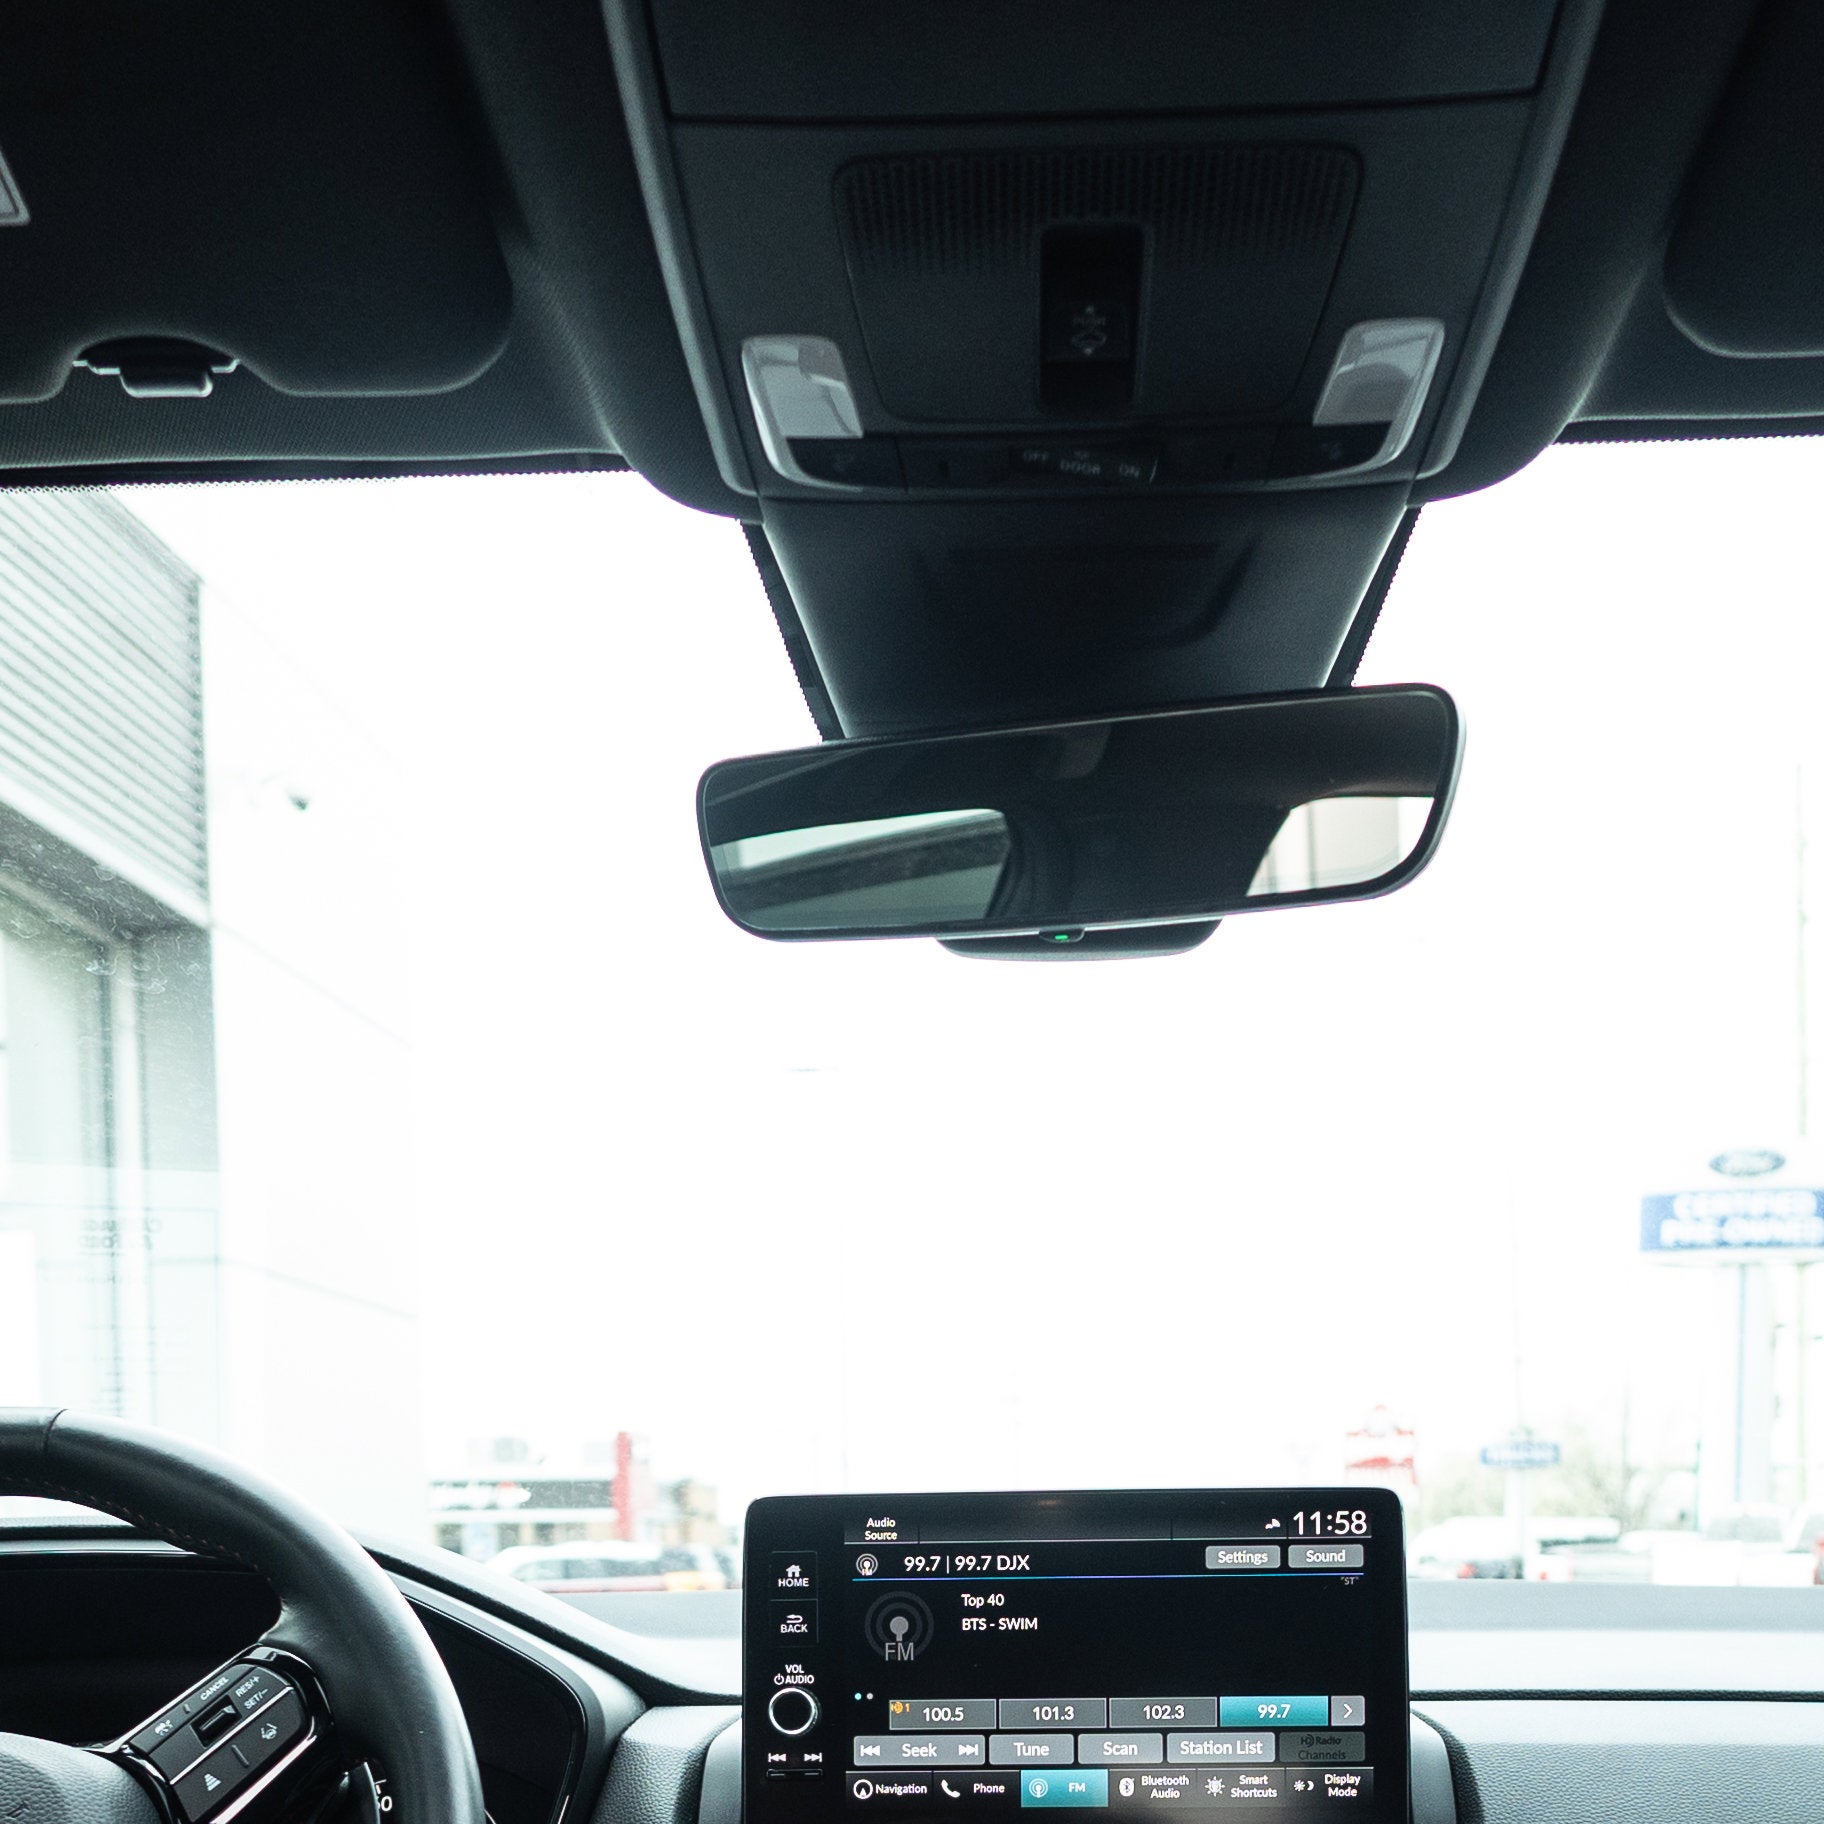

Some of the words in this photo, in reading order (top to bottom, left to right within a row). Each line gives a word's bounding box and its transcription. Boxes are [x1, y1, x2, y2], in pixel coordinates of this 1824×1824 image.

[866, 1517, 897, 1529] Audio
[1291, 1510, 1368, 1536] 11:58
[864, 1530, 898, 1541] Source
[904, 1555, 940, 1572] 99.7
[954, 1555, 992, 1572] 99.7
[997, 1555, 1030, 1572] DJX
[1216, 1549, 1269, 1566] Settings
[1305, 1548, 1346, 1564] Sound
[777, 1577, 810, 1588] HOME
[961, 1594, 983, 1610] Top
[986, 1593, 1005, 1607] 40
[780, 1623, 809, 1634] BACK
[961, 1618, 986, 1631] BTS
[998, 1617, 1038, 1631] SWIM
[884, 1642, 915, 1661] FM
[784, 1664, 805, 1674] VOL
[235, 1675, 260, 1698] RES/+
[784, 1674, 815, 1684] AUDIO
[200, 1676, 230, 1701] CANCEL
[922, 1706, 965, 1722] 100.5
[1032, 1705, 1075, 1721] 101.3
[1142, 1705, 1185, 1721] 102.3
[1256, 1704, 1291, 1719] 99.7
[901, 1742, 938, 1758] Seek
[1013, 1742, 1050, 1758] Tune
[1102, 1741, 1138, 1757] Scan
[1179, 1739, 1233, 1756] Station
[1235, 1739, 1263, 1756] List
[1297, 1748, 1347, 1761] Channels
[973, 1782, 1005, 1794] Phone
[1068, 1781, 1086, 1794] FM
[1141, 1775, 1190, 1787] Bluetooth
[1238, 1774, 1269, 1787] Smart
[1324, 1773, 1361, 1788] Display
[875, 1782, 928, 1797] Navigation
[1150, 1787, 1181, 1799] Audio
[1230, 1786, 1278, 1799] Shortcuts
[1327, 1785, 1357, 1798] Mode
